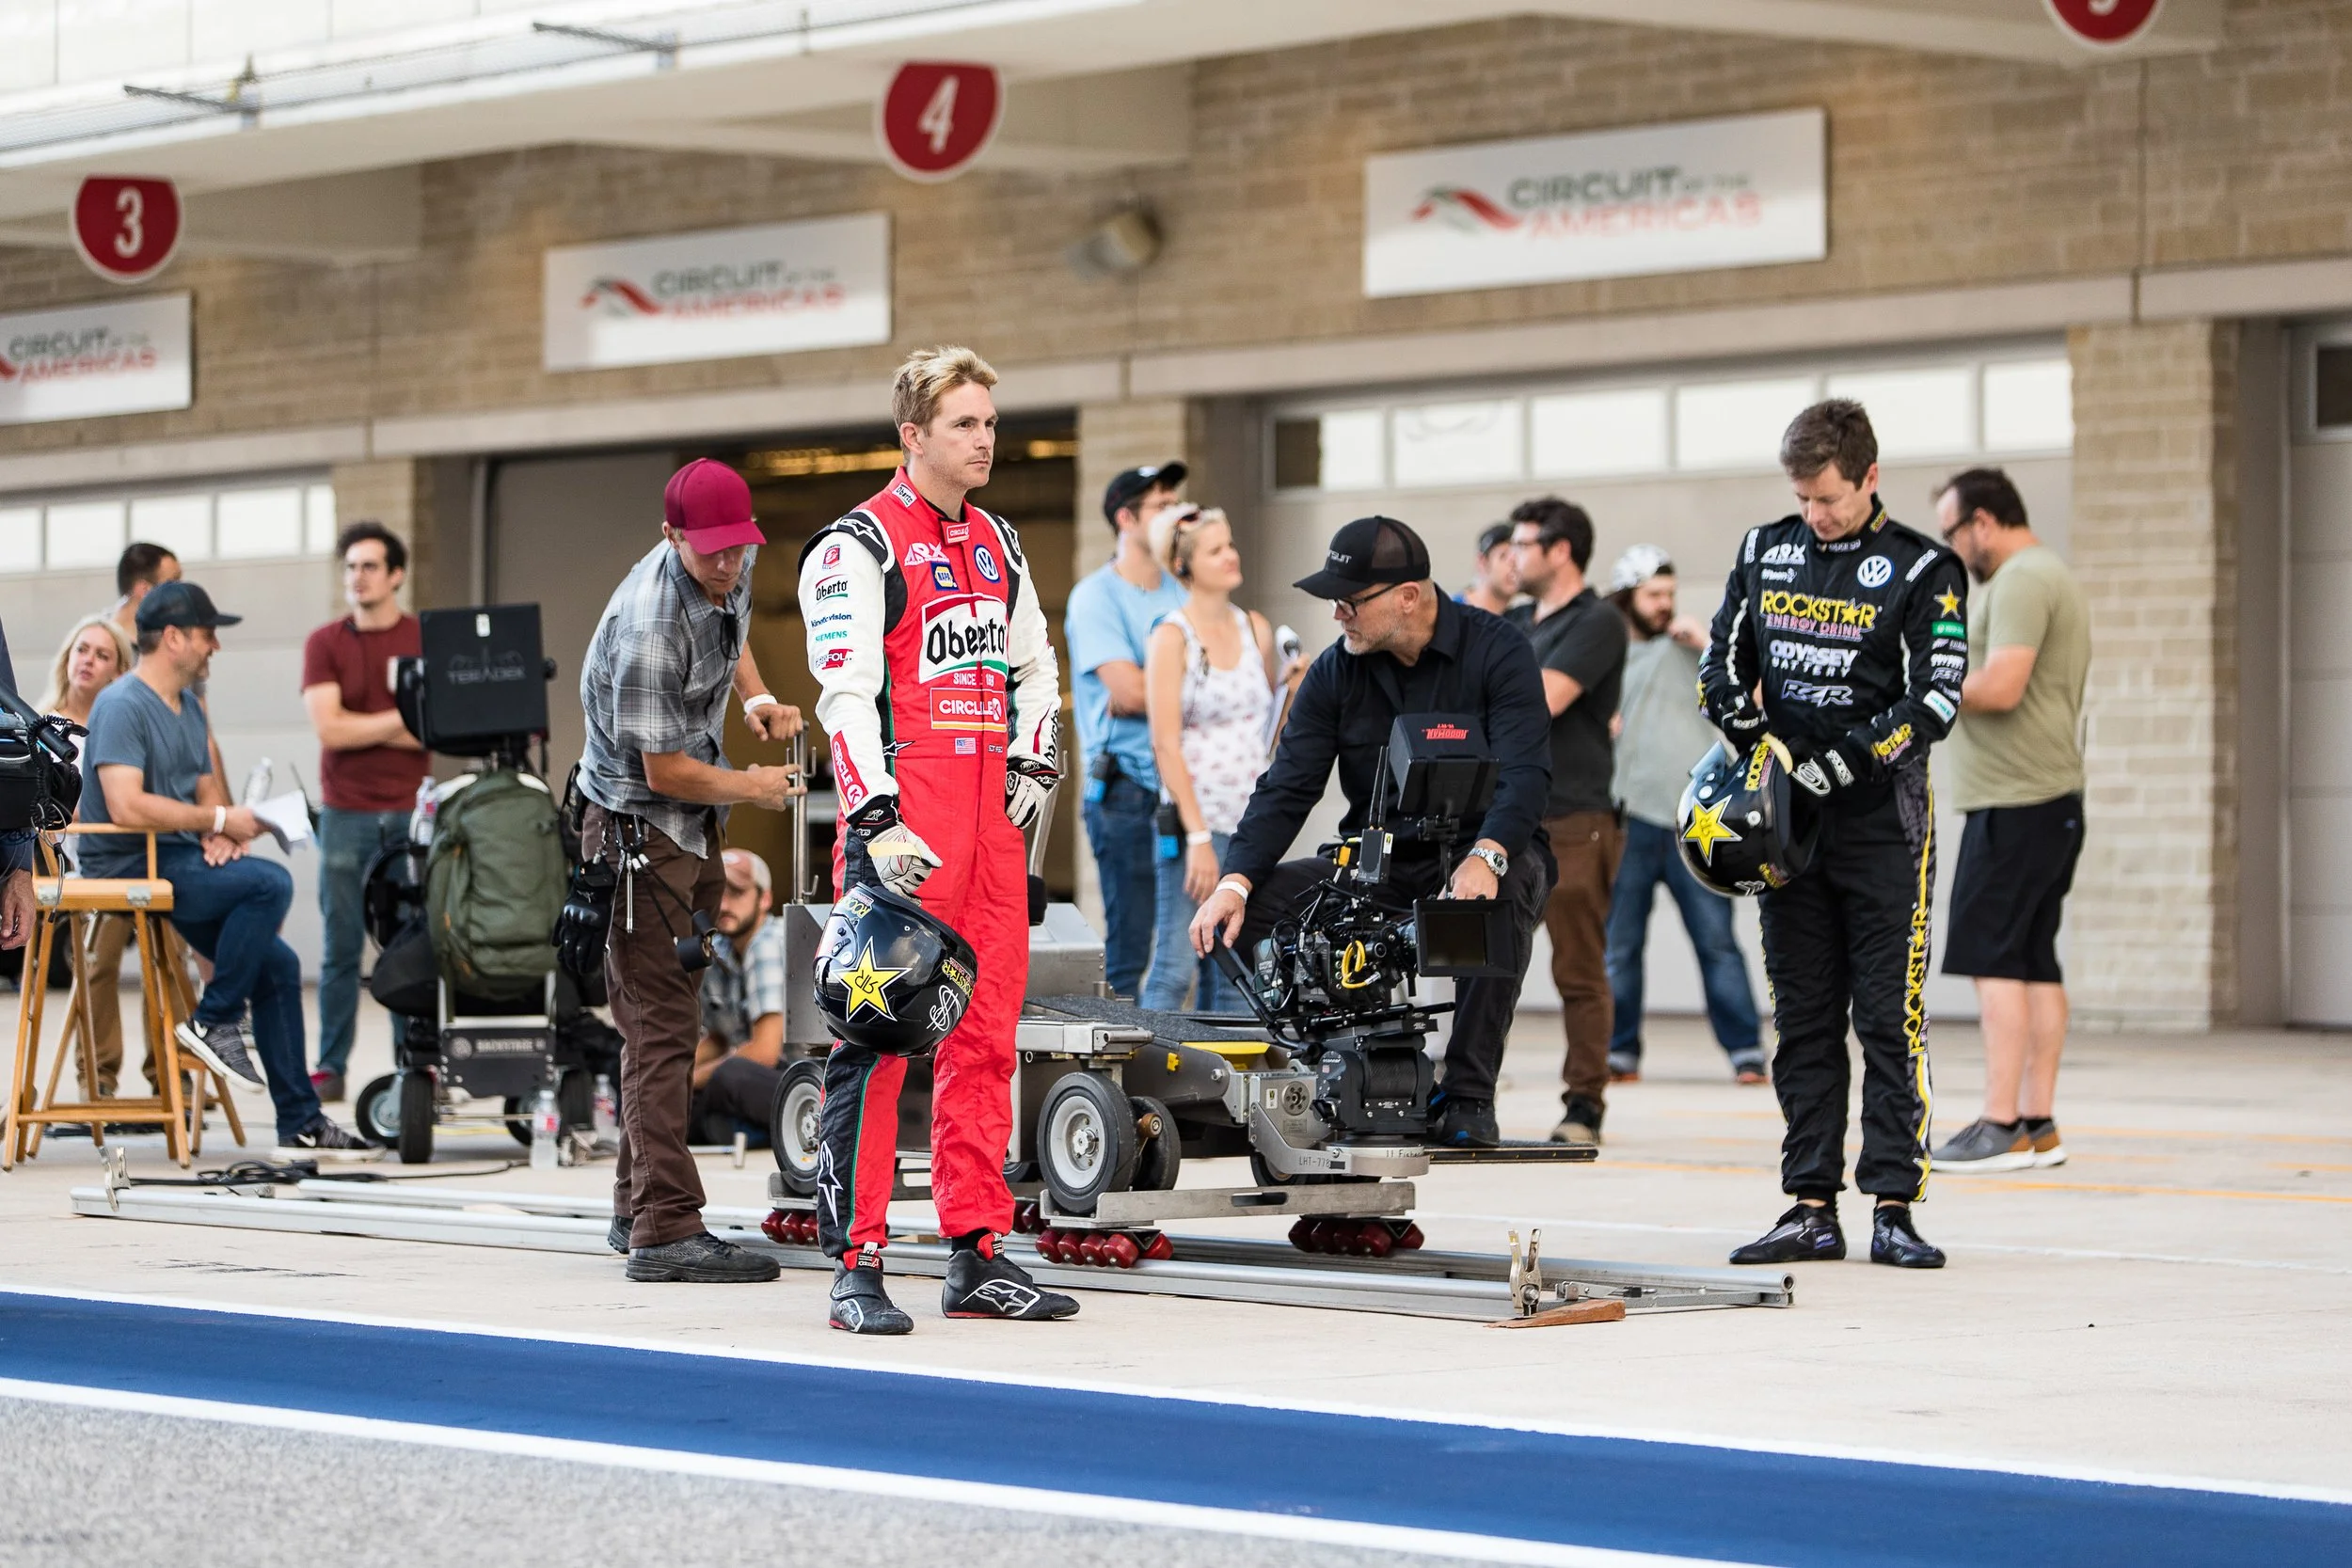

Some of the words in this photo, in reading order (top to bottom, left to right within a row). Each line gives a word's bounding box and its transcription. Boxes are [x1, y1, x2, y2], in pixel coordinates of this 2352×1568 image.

[917, 74, 960, 154] 4
[1510, 166, 1682, 210] CIRCUIT
[115, 187, 144, 260] 3
[1528, 192, 1766, 239] AMERICAS
[652, 261, 783, 298] CIRCUIT
[670, 284, 845, 320] AMERICAS
[8, 326, 108, 361] CIRCUIT
[21, 348, 157, 385] AMERICAS
[897, 485, 914, 503] Oberto
[816, 580, 849, 601] Oberto
[937, 571, 950, 580] NAPA
[816, 630, 848, 641] SIEMENS
[1820, 622, 1861, 638] DRINK
[953, 673, 977, 686] SINCE
[834, 740, 853, 787] CIRCLE
